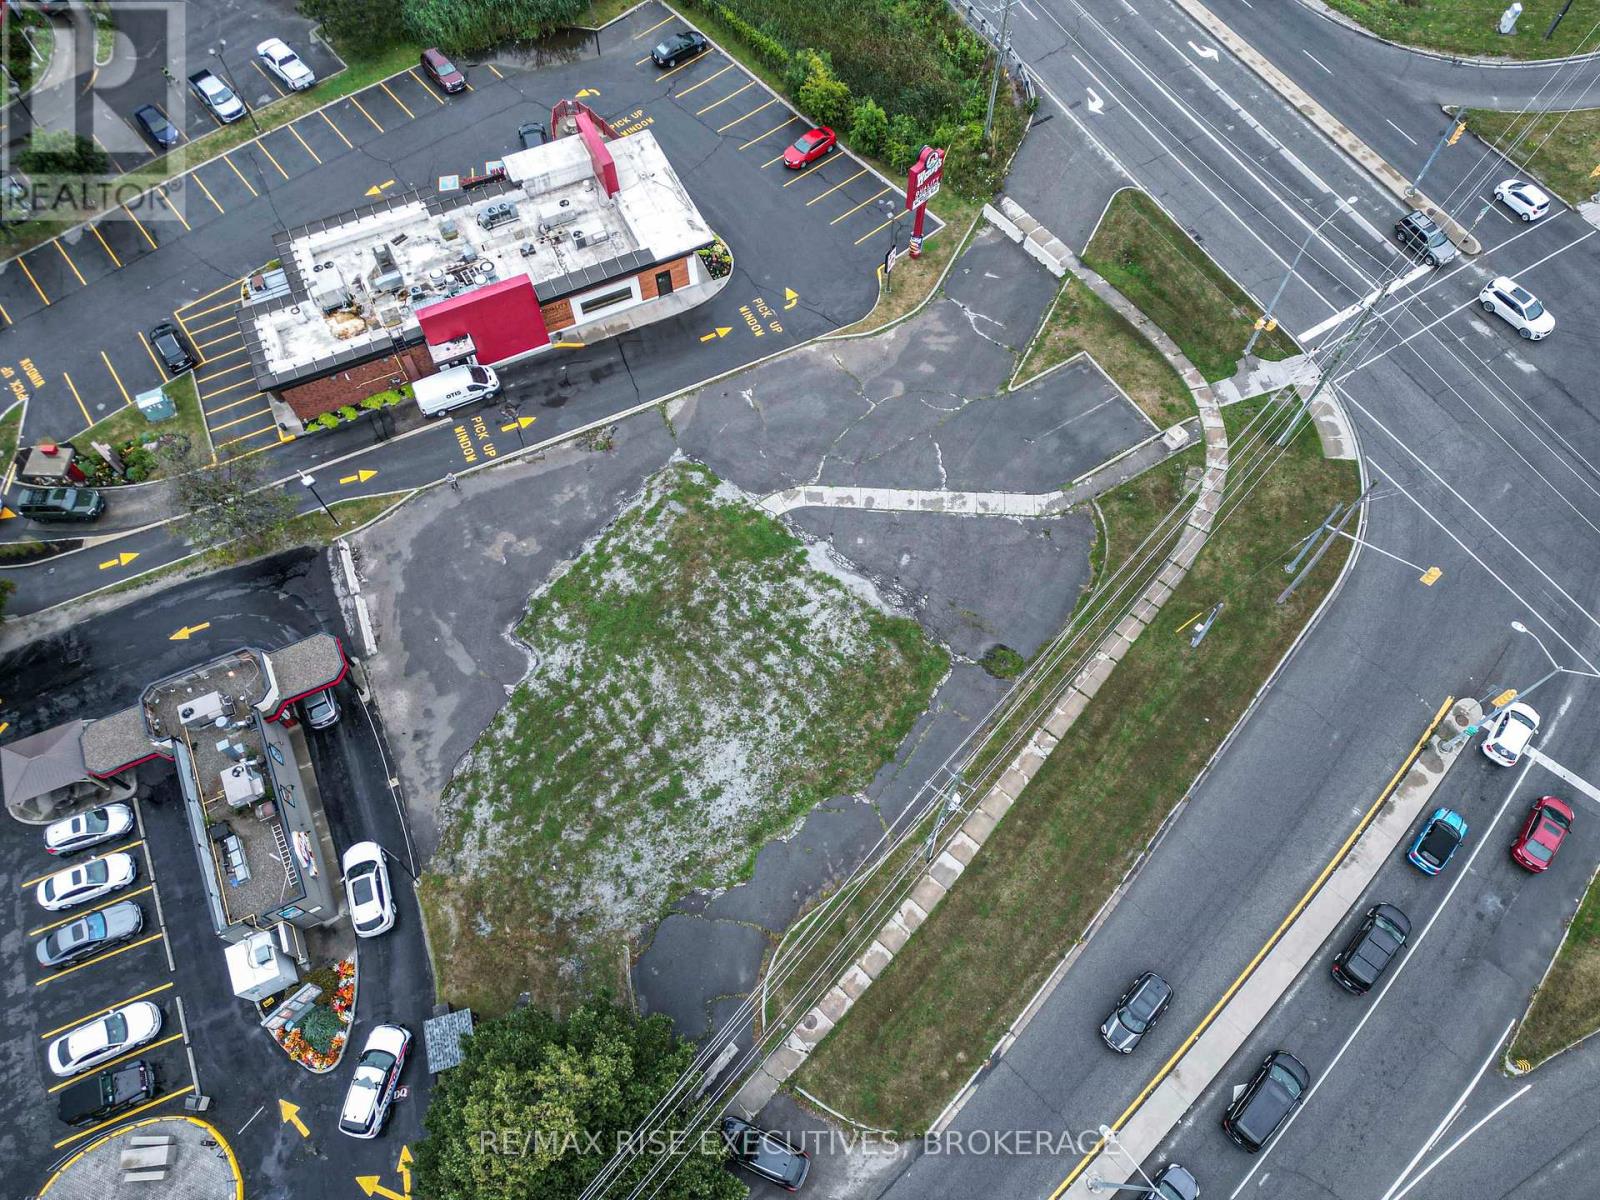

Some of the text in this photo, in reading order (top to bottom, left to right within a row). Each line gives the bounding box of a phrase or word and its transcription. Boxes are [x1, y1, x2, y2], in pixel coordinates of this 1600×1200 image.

[609, 109, 643, 130] PICK UP
[619, 116, 655, 137] WINDOW
[738, 305, 766, 337] WINDOW
[752, 297, 783, 334] PICK UP
[453, 425, 477, 463] WINDOW
[471, 416, 497, 457] PICK UP
